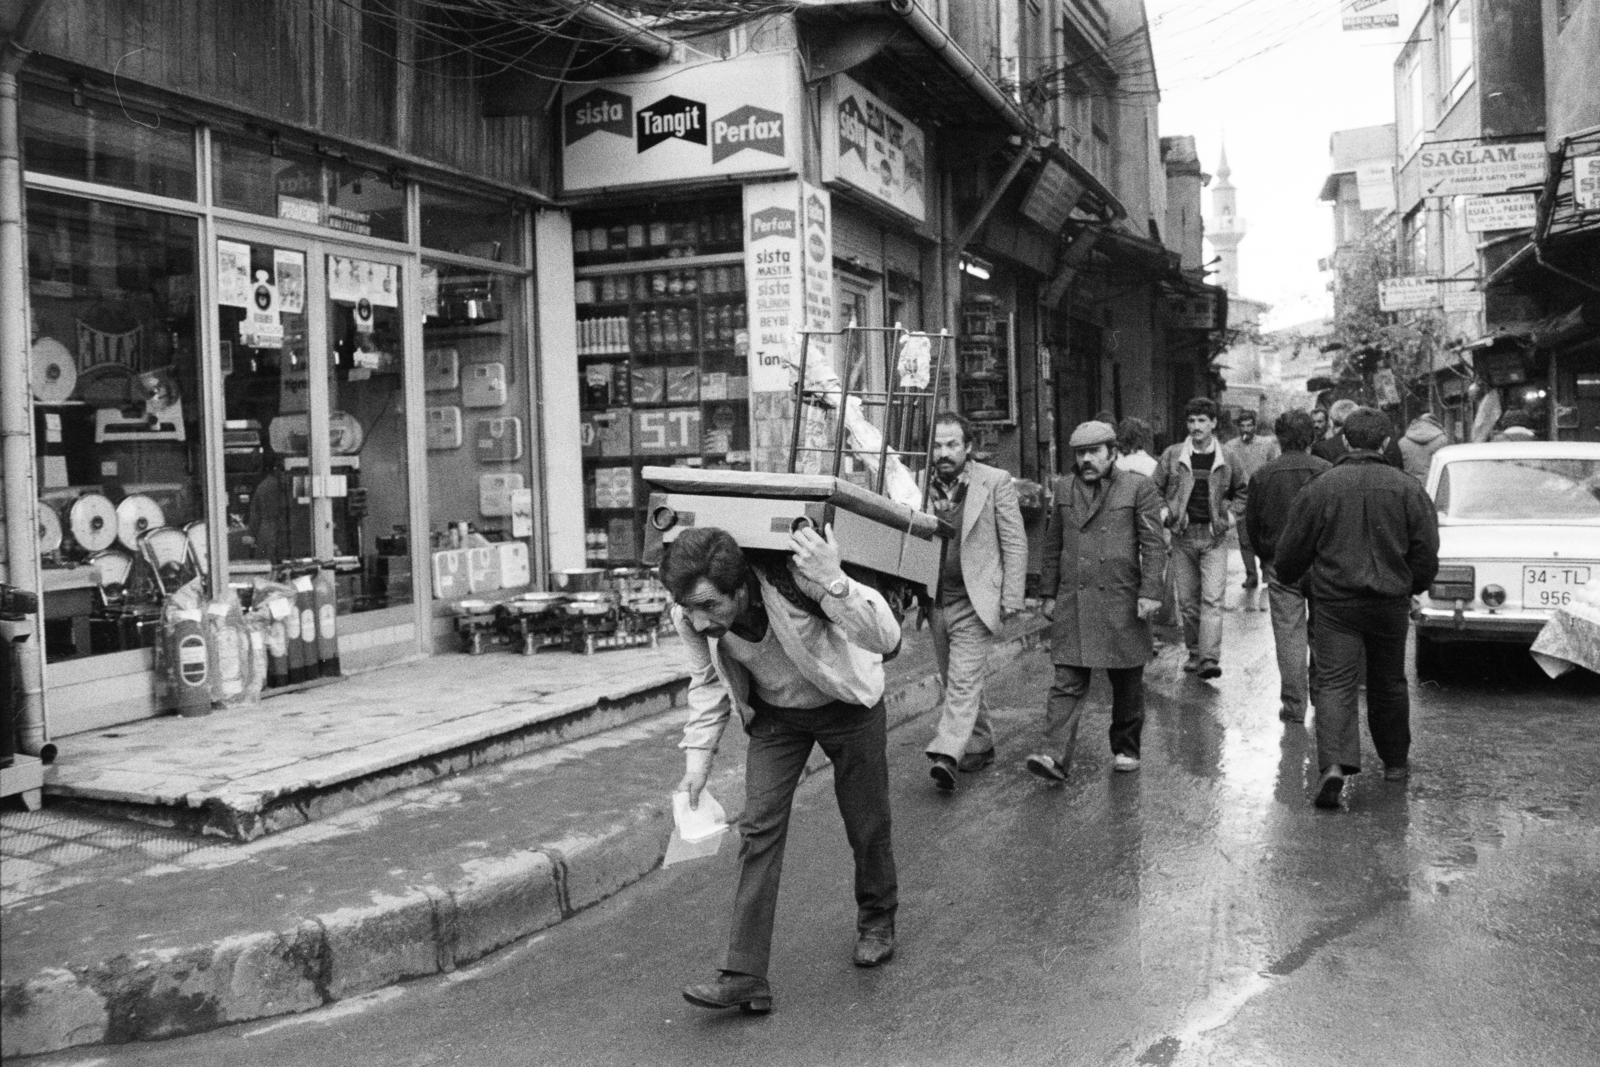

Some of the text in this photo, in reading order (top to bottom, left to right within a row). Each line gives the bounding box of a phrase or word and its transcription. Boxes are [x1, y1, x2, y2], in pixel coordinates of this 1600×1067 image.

[576, 102, 622, 125] sista
[641, 106, 700, 137] Tangit
[714, 116, 781, 144] Perfax
[754, 216, 792, 233] Perfax
[756, 248, 790, 264] sista
[758, 280, 790, 296] sista
[1540, 590, 1570, 606] 956
